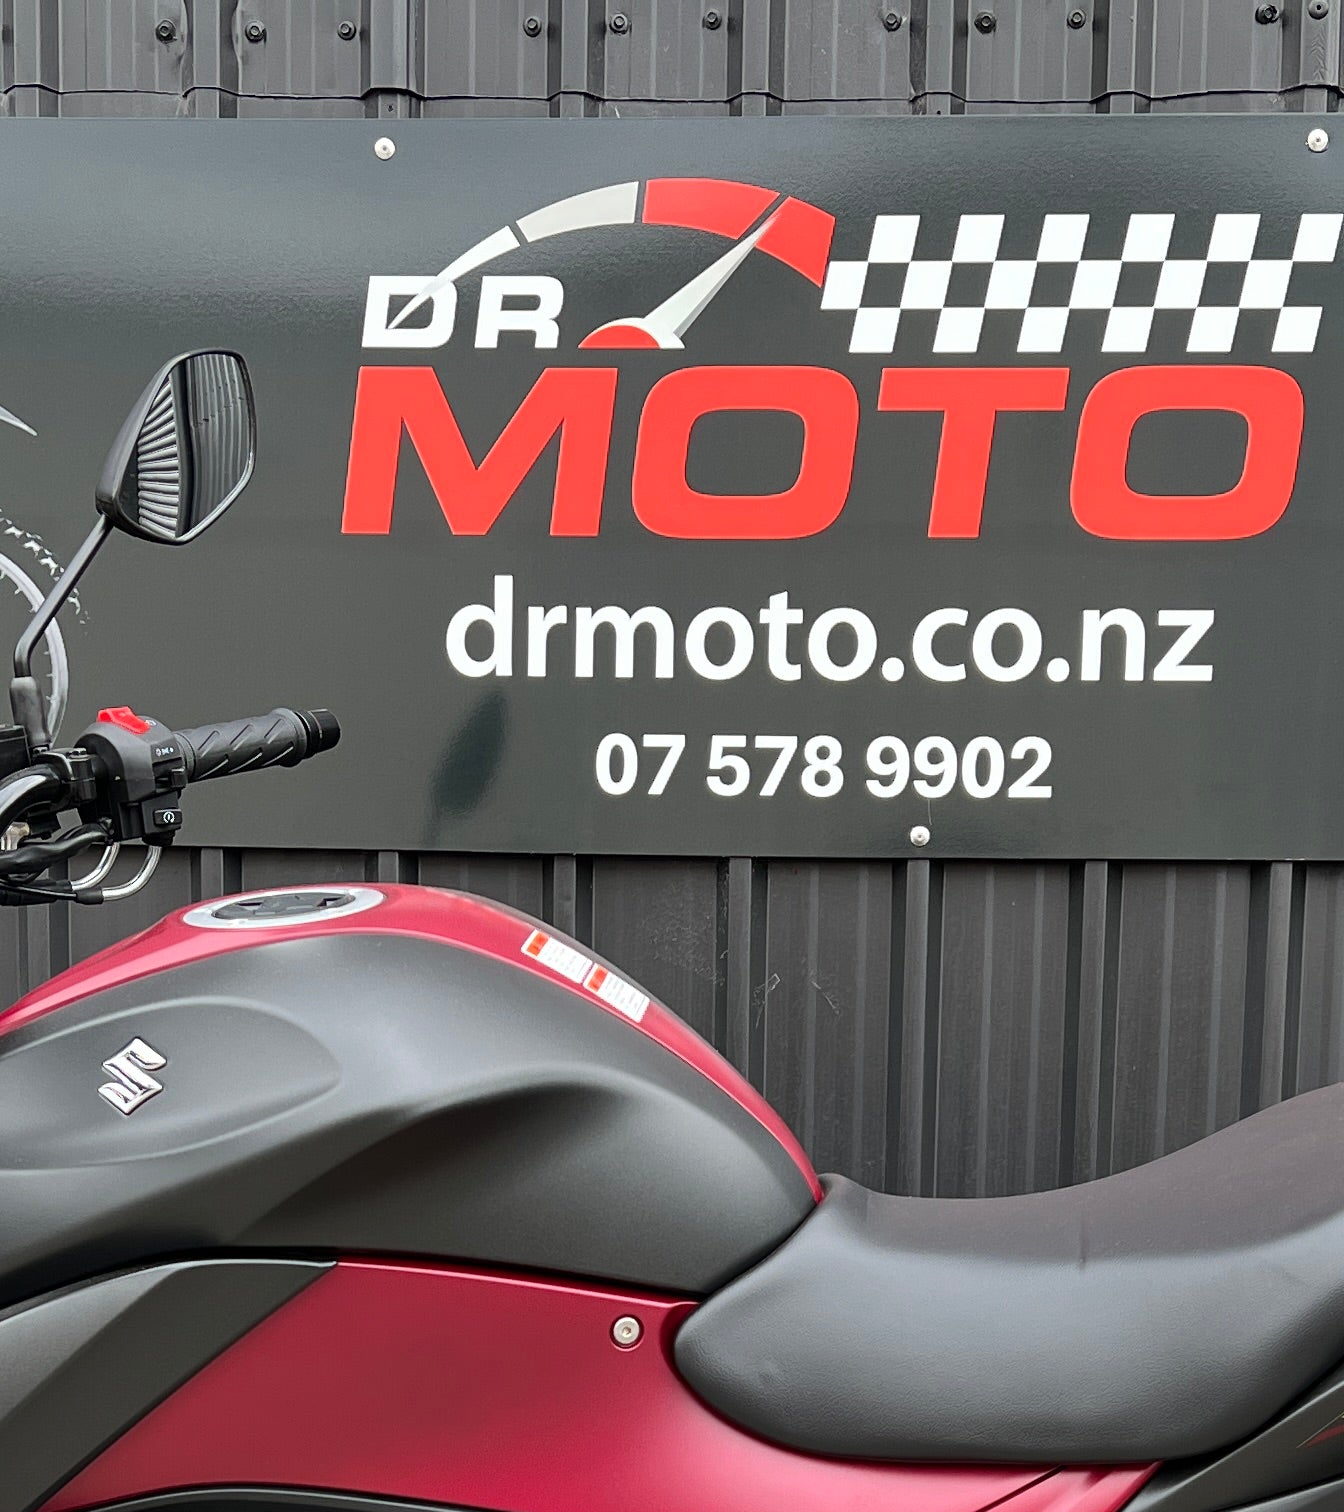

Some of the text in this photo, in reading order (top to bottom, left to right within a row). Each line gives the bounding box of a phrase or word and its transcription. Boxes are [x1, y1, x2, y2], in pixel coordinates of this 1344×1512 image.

[361, 272, 565, 350] DR
[341, 364, 1305, 541] MOTO
[445, 574, 1216, 683] drmoto.co.nz
[594, 732, 1054, 799] 07 578 9902
